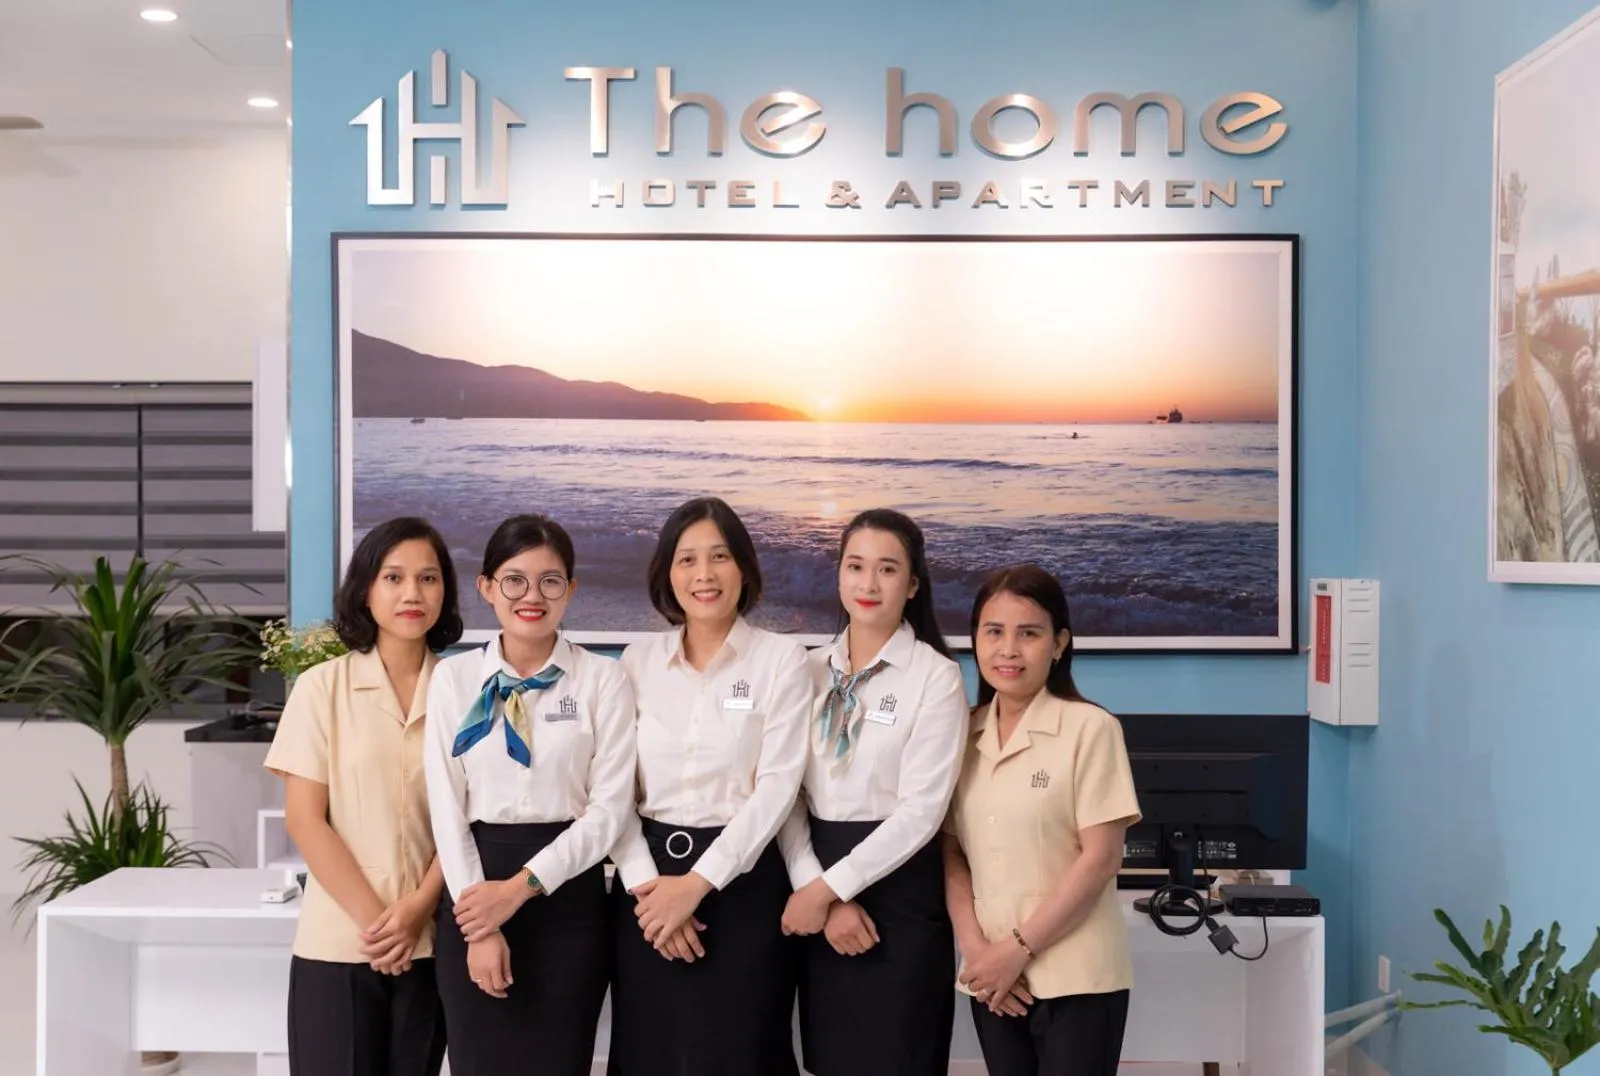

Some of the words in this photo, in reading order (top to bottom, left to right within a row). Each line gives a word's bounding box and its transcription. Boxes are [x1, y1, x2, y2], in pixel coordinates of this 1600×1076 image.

[564, 66, 827, 158] The
[885, 66, 1288, 160] home
[589, 178, 800, 209] HOTEL
[825, 179, 862, 209] &
[885, 178, 1284, 209] APARTMENT
